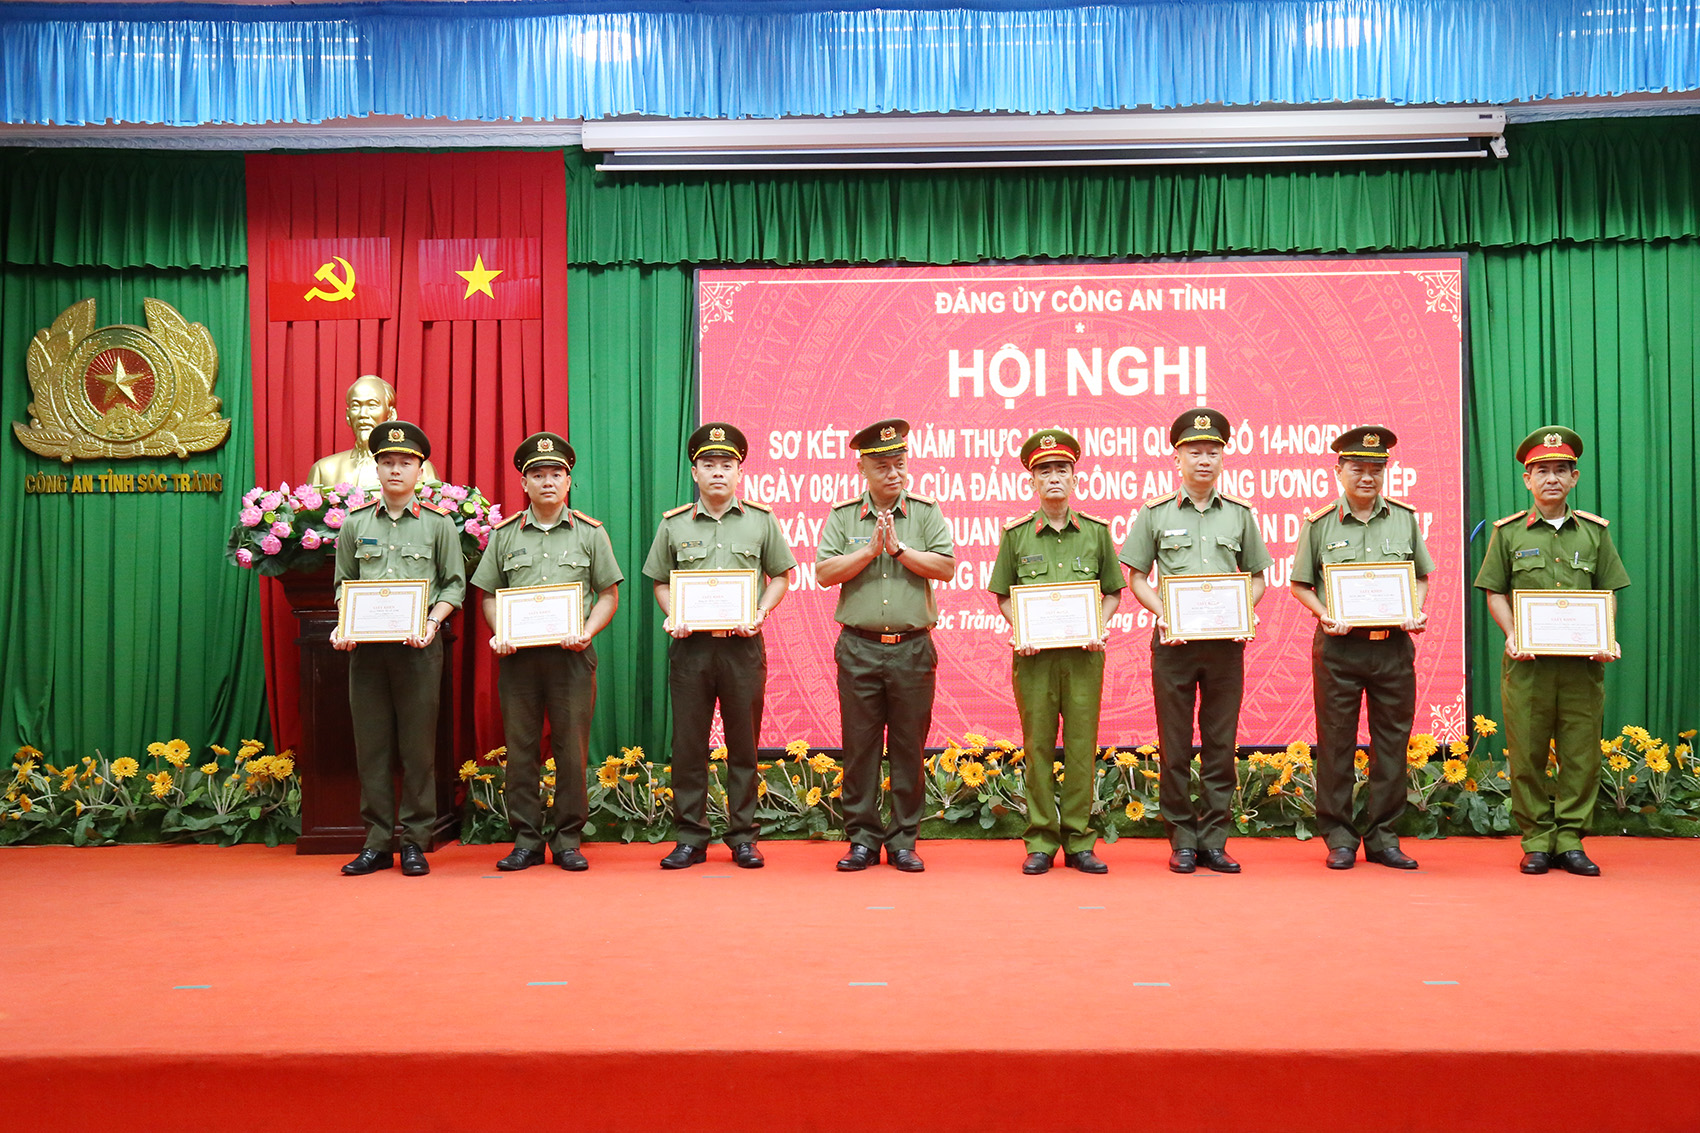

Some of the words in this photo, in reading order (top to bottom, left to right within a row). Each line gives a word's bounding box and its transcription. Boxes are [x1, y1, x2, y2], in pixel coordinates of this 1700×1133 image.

[935, 287, 1006, 314] ĐẢNG
[1012, 286, 1046, 313] ỦY
[1051, 285, 1122, 312] CÔNG
[1128, 289, 1163, 311] AN
[1169, 283, 1226, 310] TỈNH
[949, 343, 1047, 410] HỘI
[1066, 345, 1207, 407] NGHỊ
[769, 429, 802, 460] SƠ
[807, 423, 850, 460] KẾT
[907, 422, 955, 459] NĂM
[960, 428, 1022, 465] THỰC
[1085, 426, 1138, 463] NGHỊ
[1222, 418, 1254, 456] SỐ
[1259, 423, 1389, 457] 14-NQ/Đ
[25, 470, 67, 494] CÔNG
[71, 474, 93, 493] AN
[98, 468, 134, 493] TỈNH
[137, 469, 168, 493] SÓC
[171, 469, 222, 493] TRĂNG
[743, 467, 805, 503] NGÀY
[919, 465, 966, 502] CỦA
[969, 465, 1033, 502] ĐẢNG
[1074, 464, 1137, 501] CÔNG
[1142, 470, 1173, 500] AN
[1261, 467, 1329, 499] ƯƠNG
[779, 512, 823, 548] XÂY
[936, 608, 955, 630] óc
[958, 608, 1011, 634] Trăng,
[1137, 608, 1149, 628] 6
